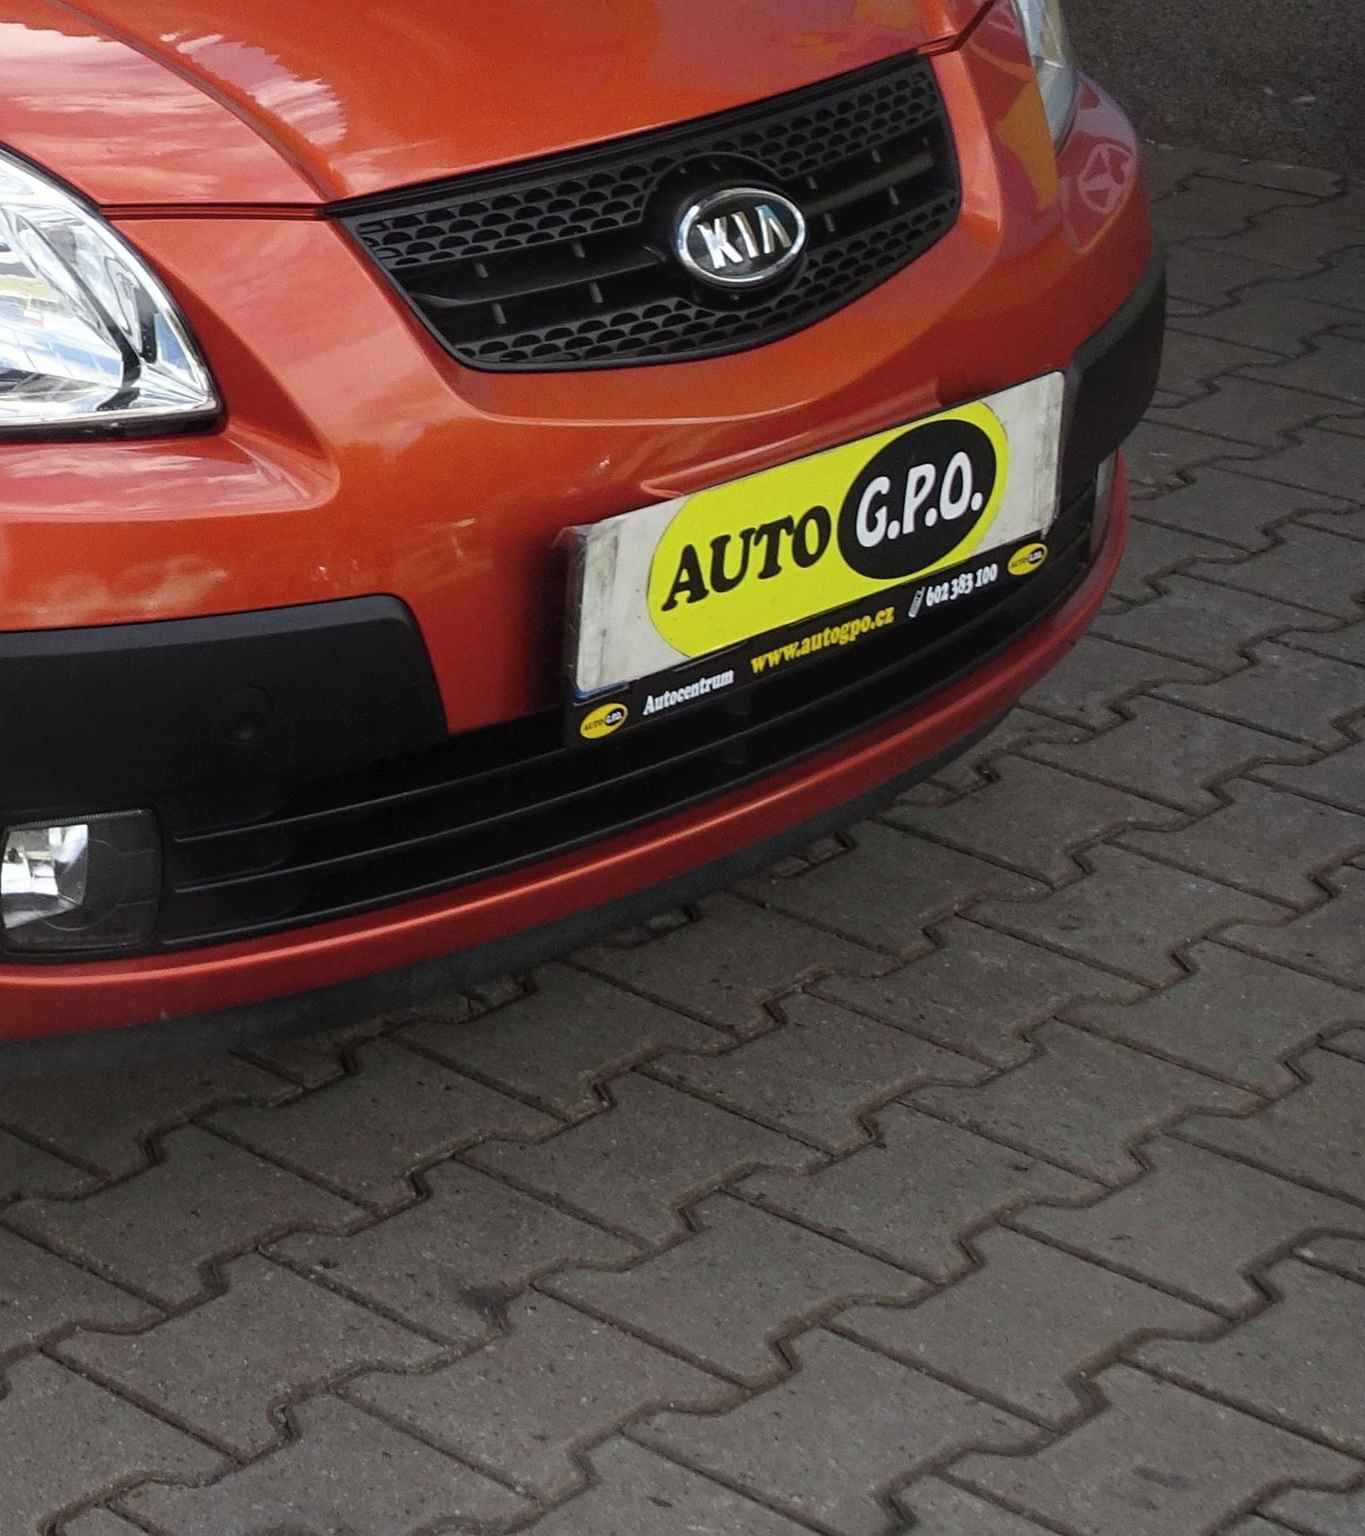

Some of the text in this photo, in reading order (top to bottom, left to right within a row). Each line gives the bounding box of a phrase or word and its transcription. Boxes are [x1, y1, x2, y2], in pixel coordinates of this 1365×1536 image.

[696, 204, 792, 270] KIA
[661, 452, 984, 611] AUTO G.P.O.
[642, 562, 999, 716] Autocentrum www.autogpo.cz 602 383 100
